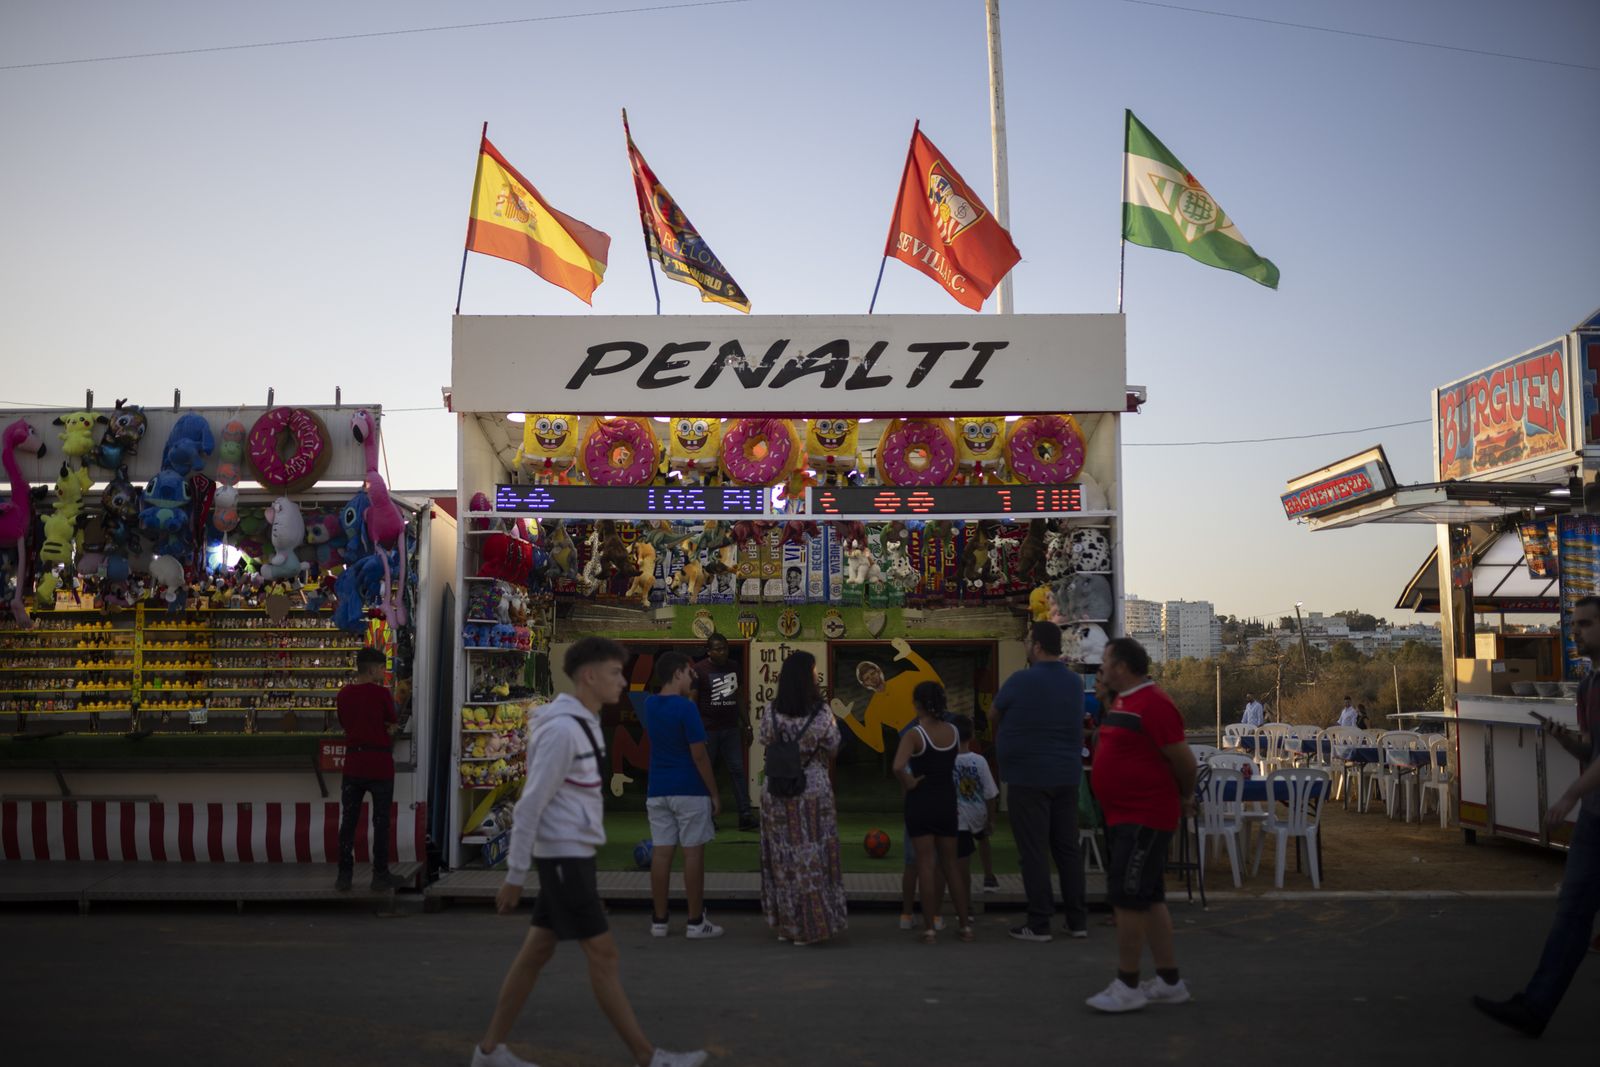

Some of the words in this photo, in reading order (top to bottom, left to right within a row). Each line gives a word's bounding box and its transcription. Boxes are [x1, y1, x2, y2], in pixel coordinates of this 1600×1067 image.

[657, 227, 728, 275] RCELON
[565, 339, 1009, 390] PENALTI
[1441, 351, 1567, 477] BURGUER
[1284, 473, 1372, 515] BAGUETTERIA
[812, 533, 822, 571] RECREA
[830, 543, 840, 575] HUELVA
[760, 649, 776, 662] un
[755, 685, 774, 703] de
